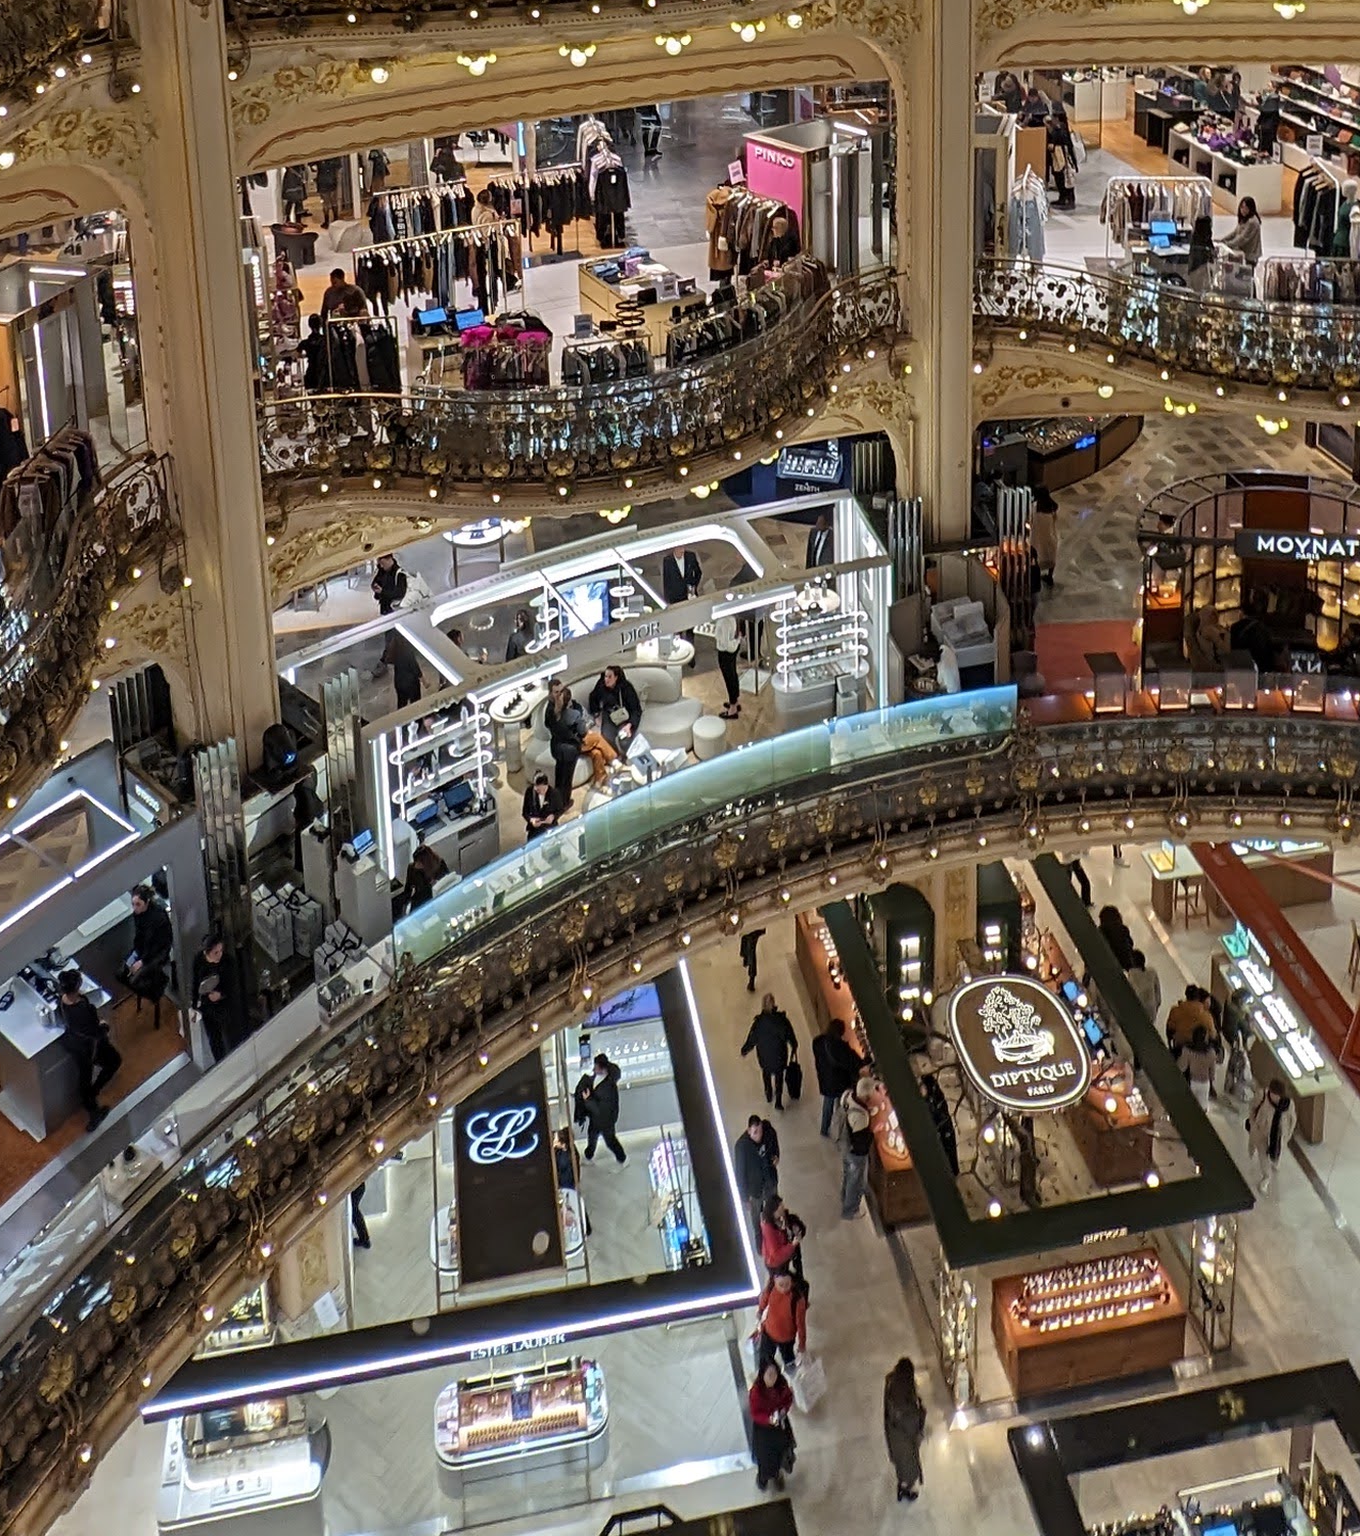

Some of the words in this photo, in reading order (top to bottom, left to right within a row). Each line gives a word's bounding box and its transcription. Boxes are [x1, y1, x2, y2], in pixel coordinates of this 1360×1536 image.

[754, 146, 795, 168] PINKO
[794, 483, 820, 493] ZENITH
[1257, 535, 1360, 557] MOYNAT
[620, 621, 662, 646] DIOR
[990, 1062, 1076, 1088] DIPTYQUE
[1027, 1084, 1055, 1097] PARIS
